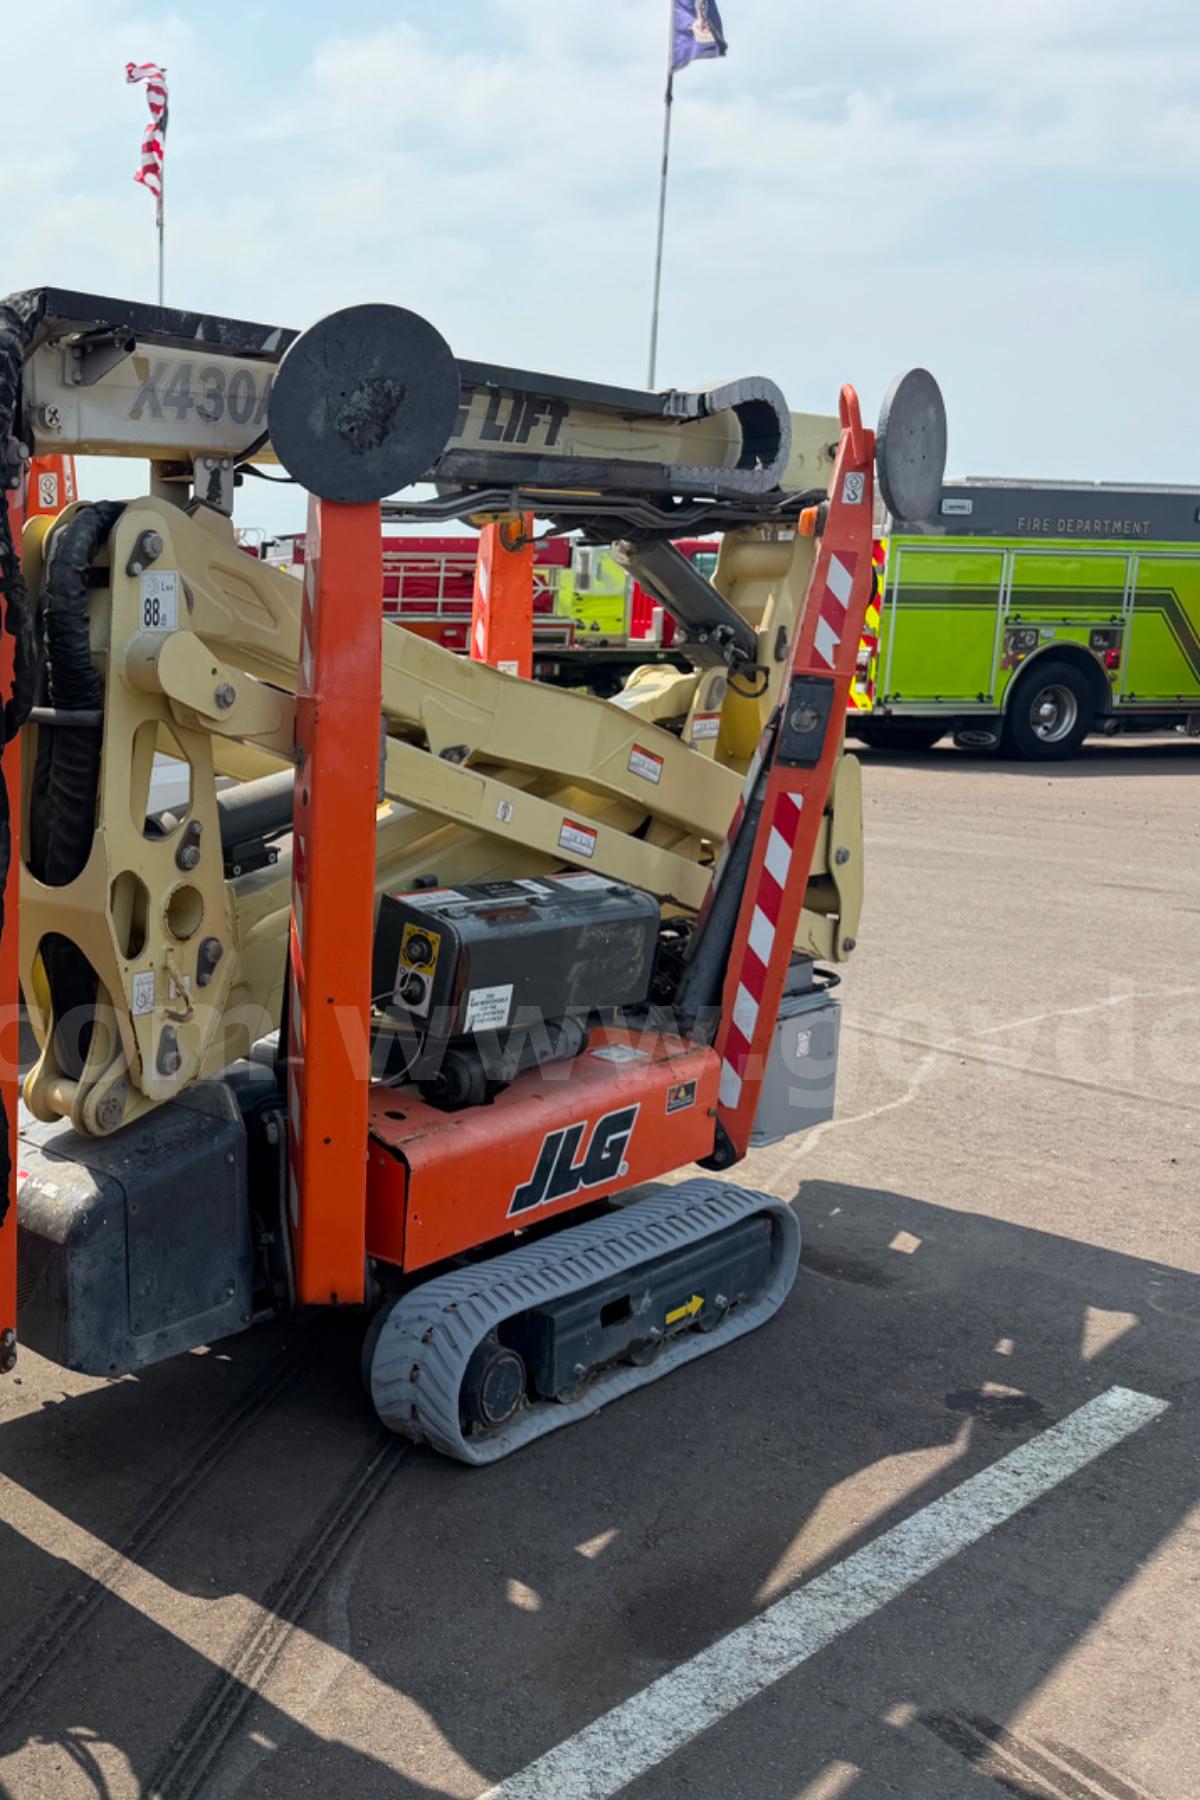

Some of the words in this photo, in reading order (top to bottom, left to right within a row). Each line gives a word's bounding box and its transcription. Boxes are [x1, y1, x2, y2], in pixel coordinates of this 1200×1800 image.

[478, 384, 570, 446] LIFT
[1017, 516, 1050, 532] FIRE
[1057, 518, 1151, 534] DEPARTMENT
[144, 597, 160, 627] 88
[506, 1103, 641, 1219] JLG
